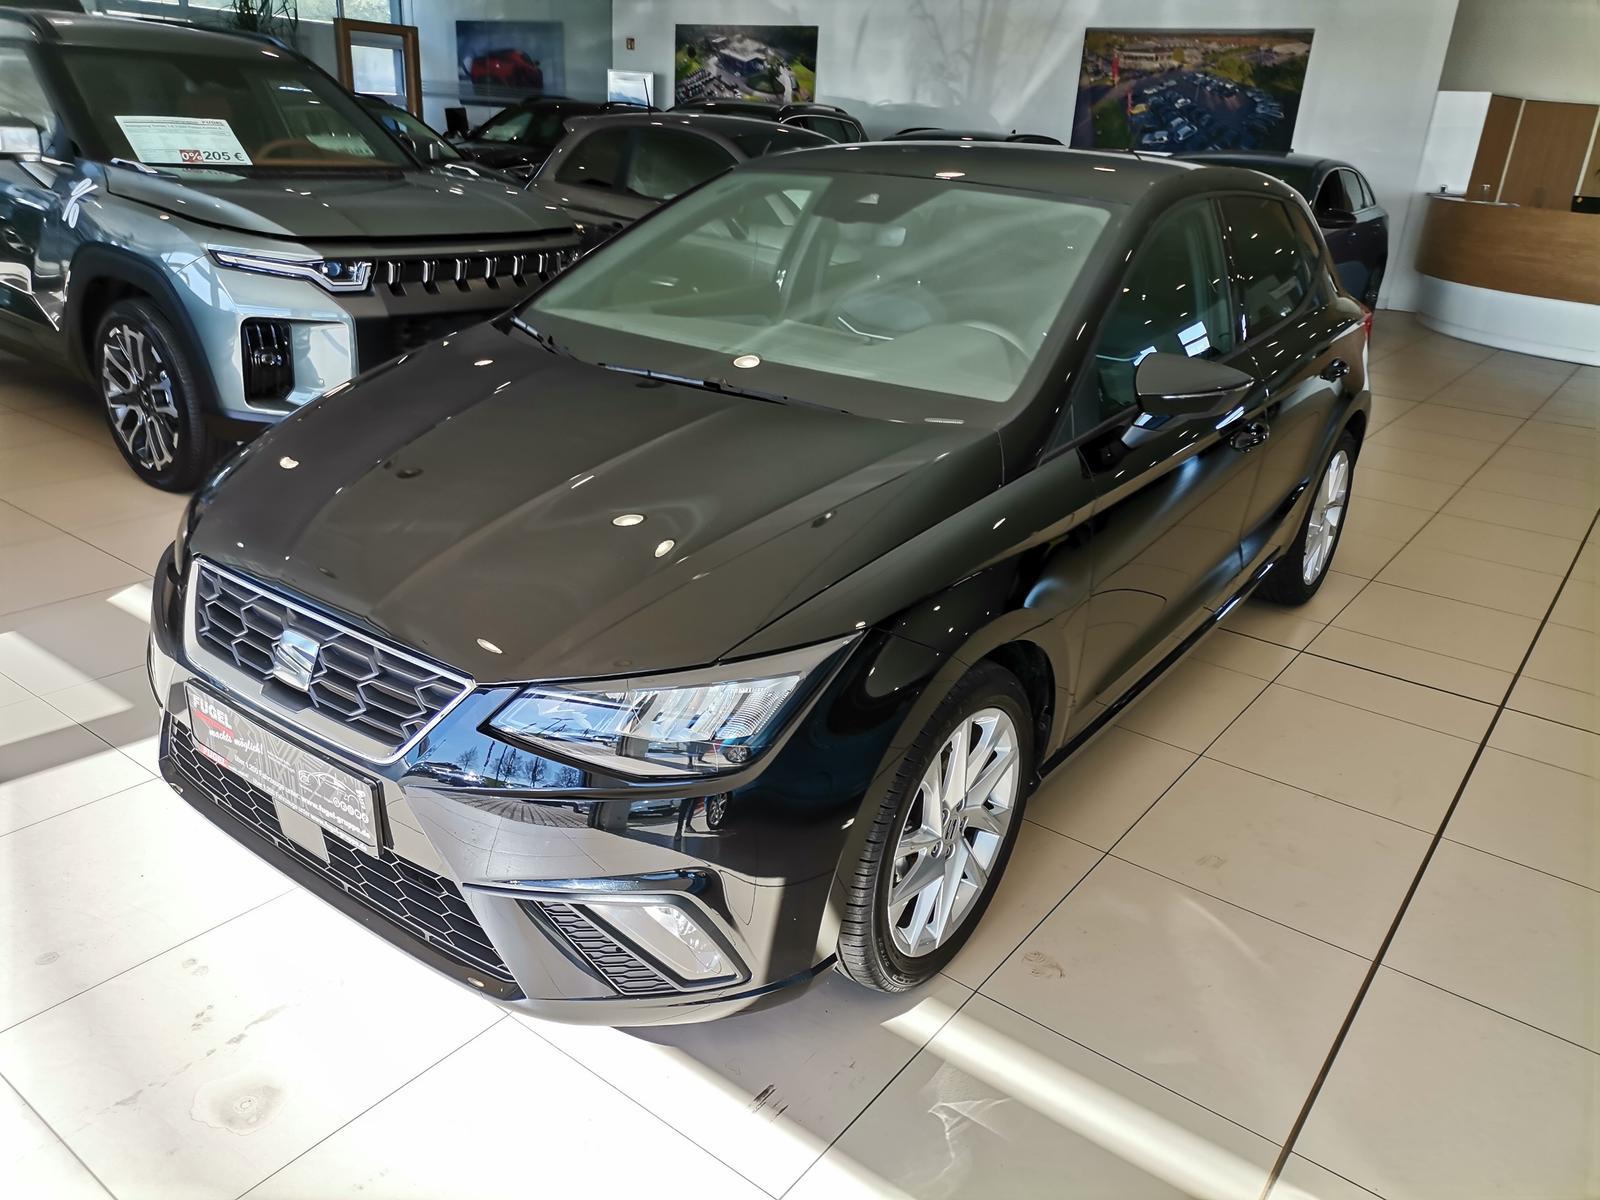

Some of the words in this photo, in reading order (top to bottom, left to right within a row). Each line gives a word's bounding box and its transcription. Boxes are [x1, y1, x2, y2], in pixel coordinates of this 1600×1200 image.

[181, 152, 203, 161] 0%
[203, 151, 231, 161] 205
[234, 152, 245, 161] €
[191, 694, 232, 730] FUGEL
